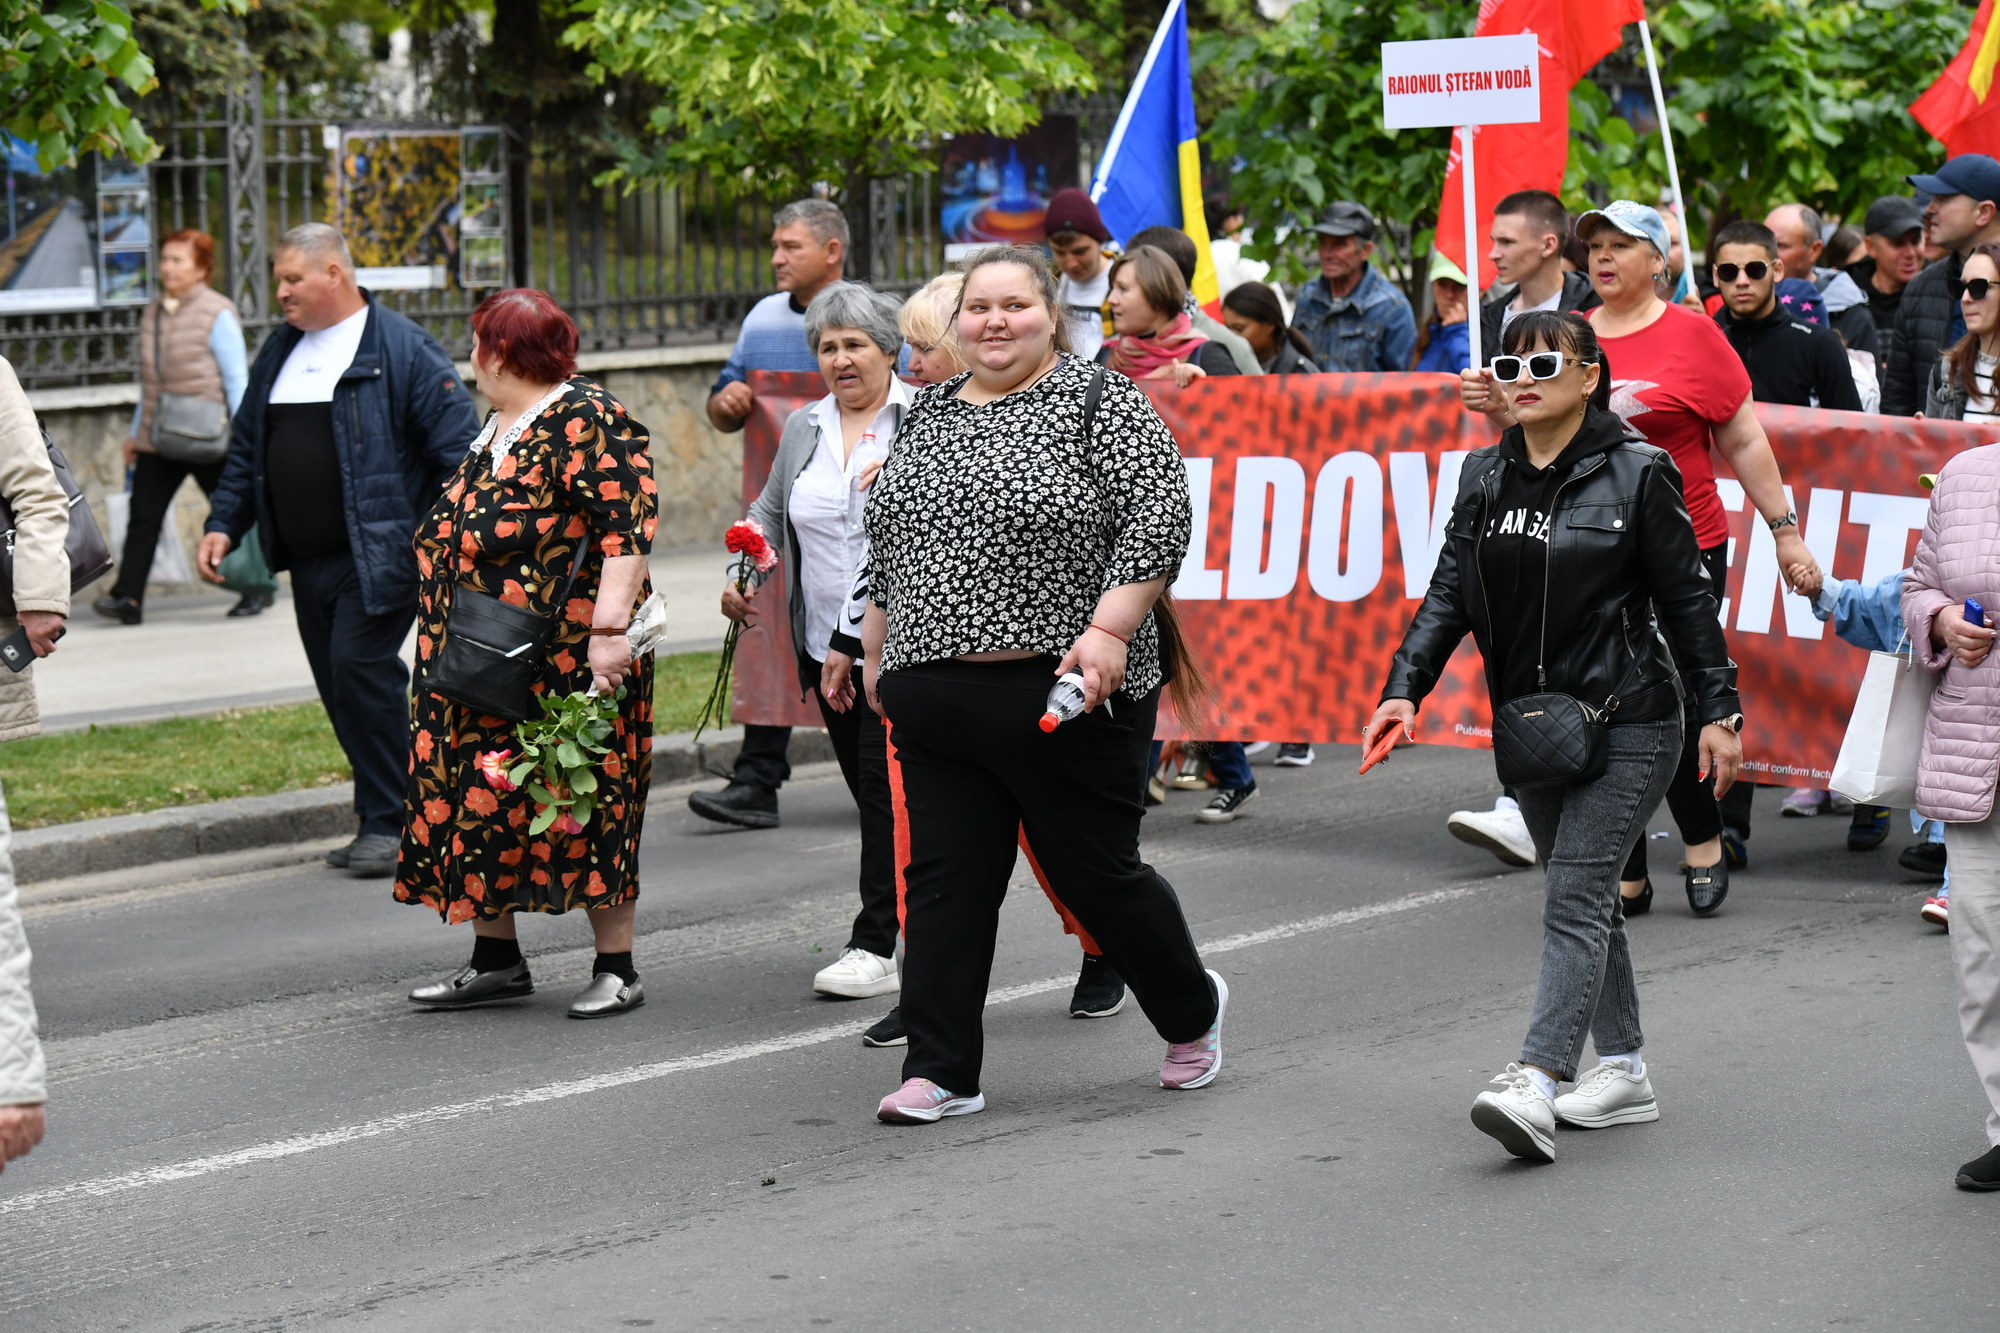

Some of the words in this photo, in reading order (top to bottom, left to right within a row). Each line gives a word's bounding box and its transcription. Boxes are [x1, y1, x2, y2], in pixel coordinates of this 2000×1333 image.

[1388, 74, 1443, 95] RAIONUL
[1445, 71, 1493, 98] ȘTEFAN
[1495, 64, 1532, 89] VODĂ
[1498, 507, 1550, 544] ANGE
[1770, 763, 1810, 778] conform
